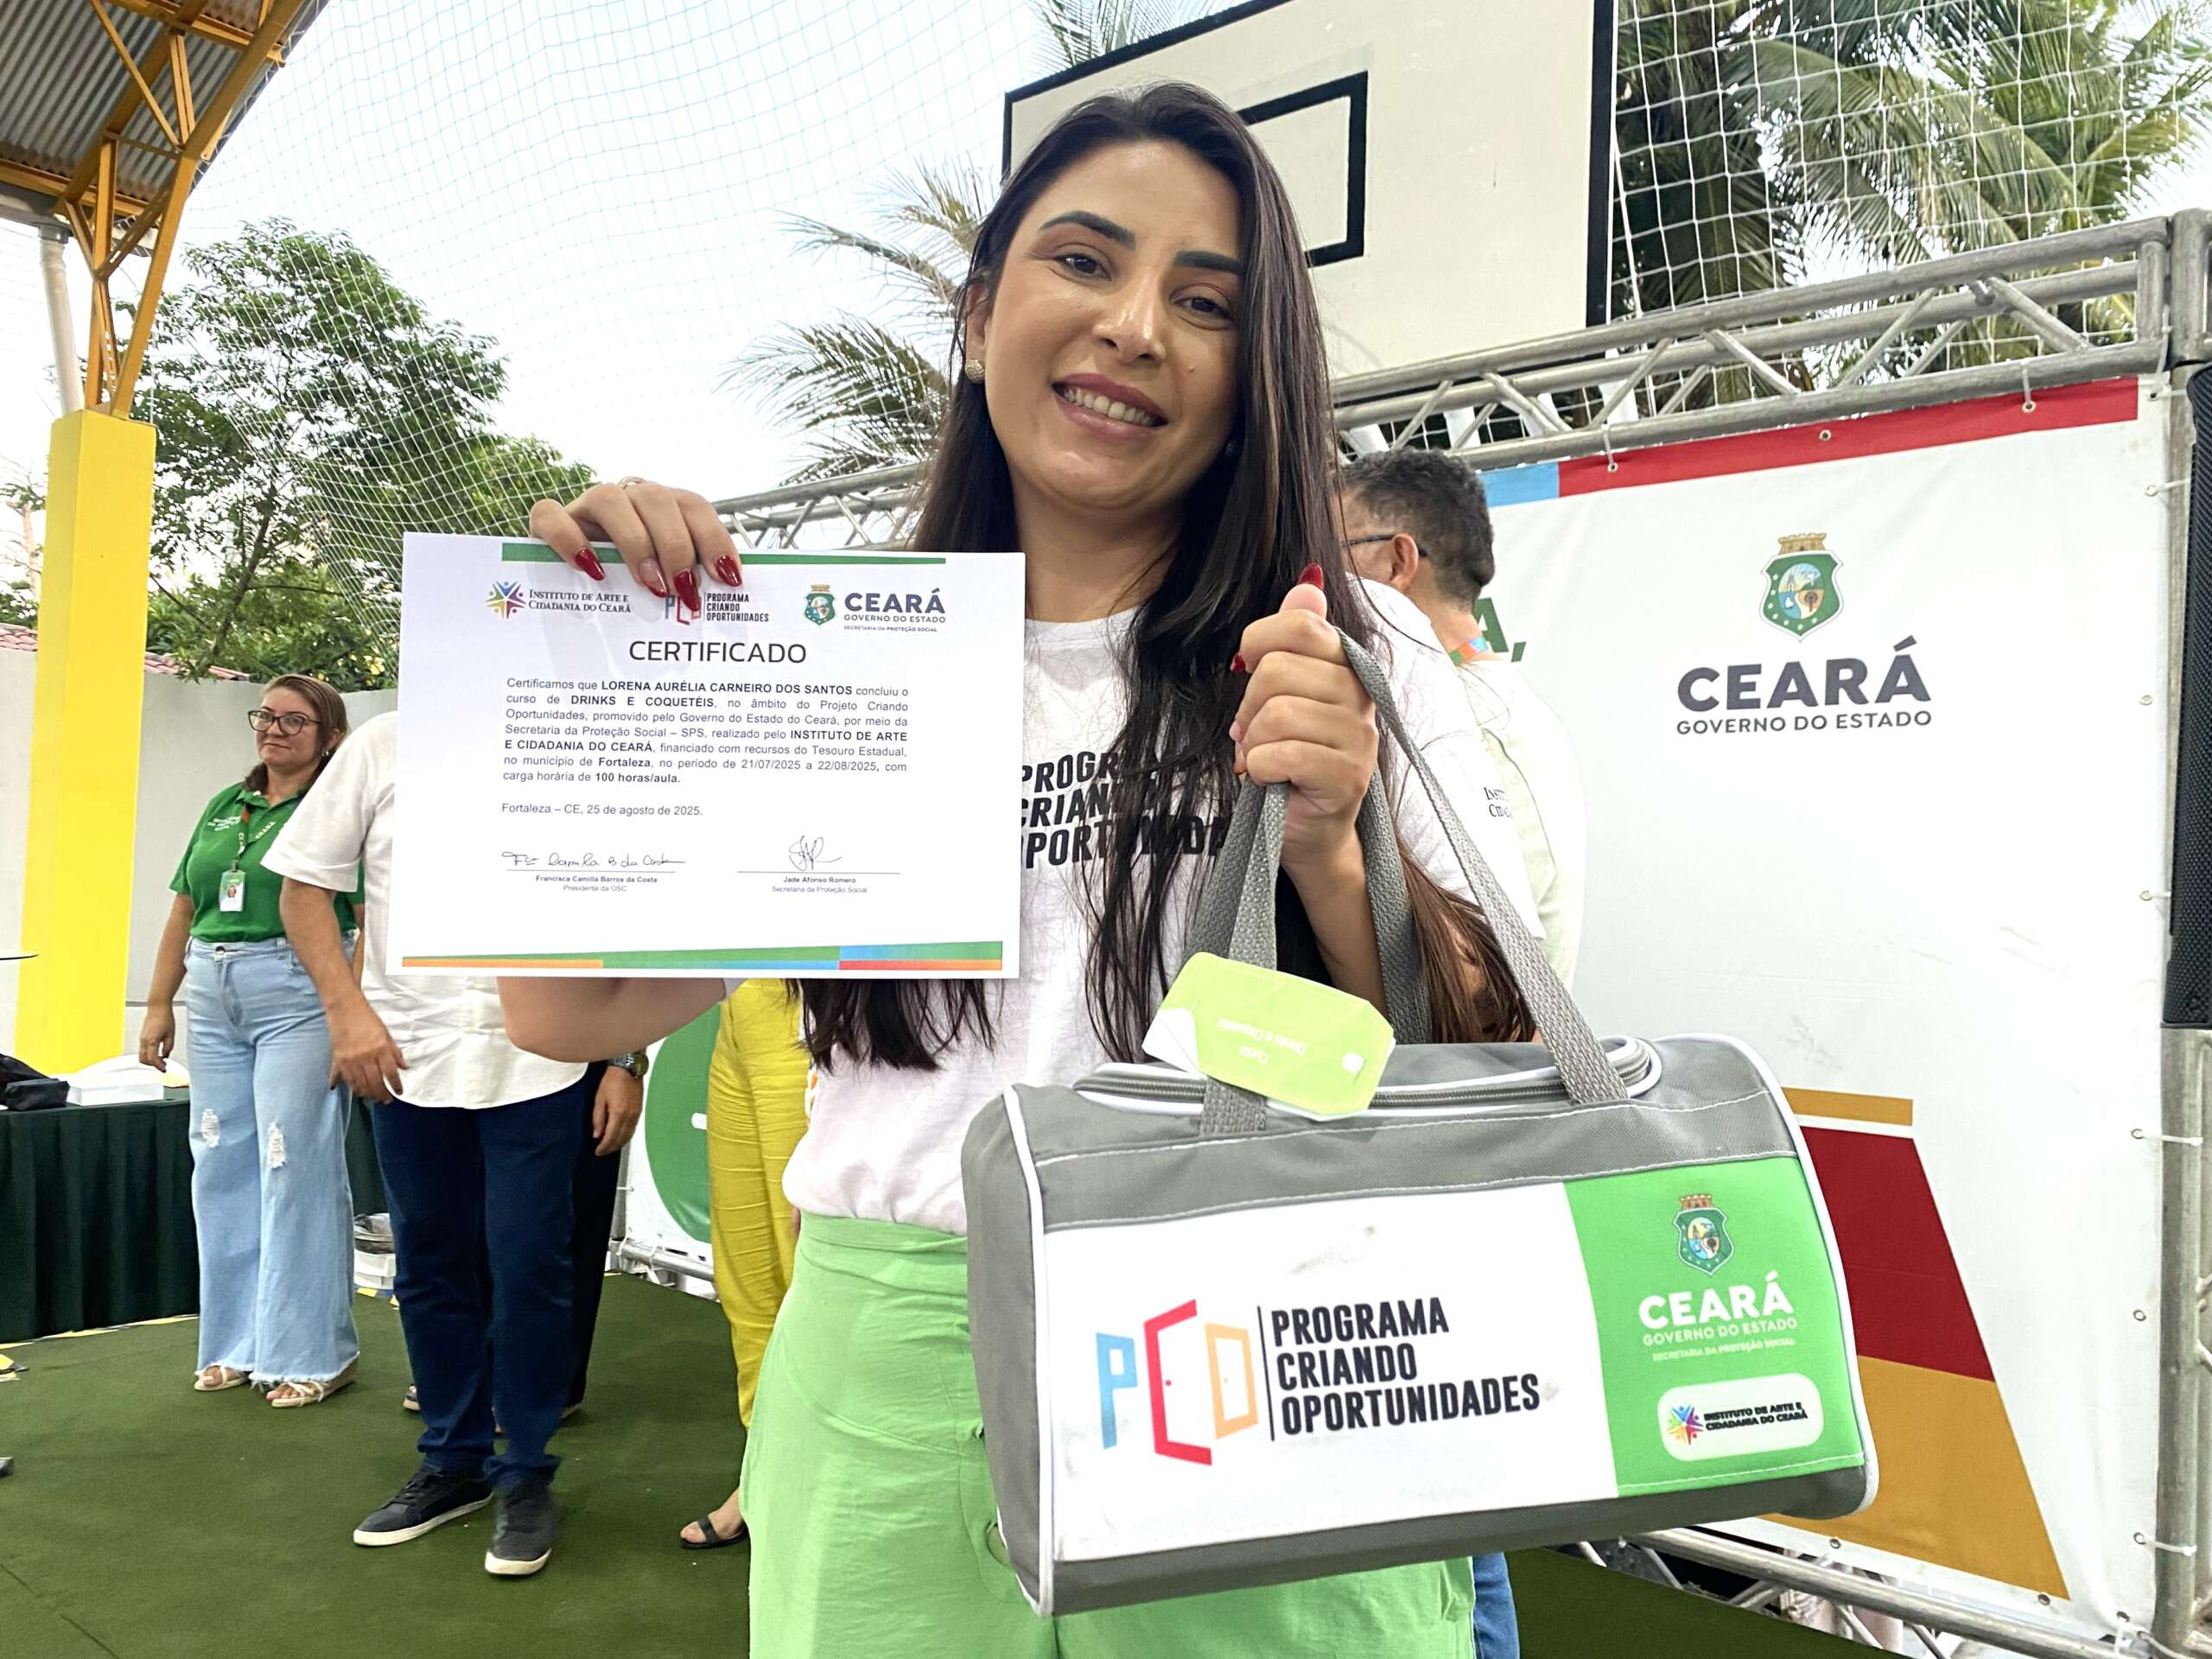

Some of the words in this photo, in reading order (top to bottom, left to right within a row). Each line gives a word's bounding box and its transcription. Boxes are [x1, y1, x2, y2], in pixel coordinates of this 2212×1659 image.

[530, 589, 579, 601] INSTITUTO
[595, 593, 620, 602] ARTE
[707, 593, 749, 602] PROGRAMA
[844, 588, 945, 613] CEARÁ
[529, 601, 580, 611] CIDADANIA
[599, 603, 631, 613] CEARÁ
[707, 603, 740, 612] CRIANDO
[707, 612, 769, 622] OPORTUNIDADES
[629, 640, 807, 664] CERTIFICADO
[1678, 635, 1931, 712] CEARÁ
[507, 677, 574, 690] Certificamos
[578, 682, 597, 691] que
[601, 681, 651, 690] LORENA
[655, 680, 706, 691] AURÉLIA
[710, 683, 772, 693] CARNEIRO
[776, 684, 800, 693] DOS
[804, 685, 852, 695] SANTOS
[856, 687, 898, 696] concluiu
[547, 695, 560, 703] de
[571, 696, 616, 705] DRINKS
[645, 696, 717, 708] COQUETÉIS,
[751, 698, 786, 709] âmbito
[797, 700, 810, 709] do
[820, 700, 857, 711] Projeto
[868, 701, 908, 711] Criando
[506, 709, 588, 721] Oportunidades,
[593, 711, 648, 722] promovido
[653, 712, 675, 723] pelo
[680, 713, 724, 722] Governo
[729, 714, 741, 722] do
[747, 714, 783, 724] Estado
[788, 715, 800, 724] do
[804, 715, 840, 726] Ceará,
[844, 717, 861, 727] por
[866, 716, 890, 726] meio
[895, 717, 907, 727] da
[1677, 716, 1786, 734] GOVERNO
[1795, 715, 1827, 730] DO
[1837, 711, 1931, 729] ESTADO
[505, 724, 560, 734] Secretaria
[565, 726, 577, 735] da
[582, 726, 630, 738] Proteção
[634, 727, 666, 736] Social
[681, 728, 707, 739] SPS,
[712, 729, 760, 739] realizado
[765, 730, 786, 741] pelo
[791, 730, 852, 740] INSTITUTO
[856, 732, 872, 741] DE
[876, 732, 907, 741] ARTE
[518, 741, 584, 750] CIDADANIA
[588, 741, 606, 751] DO
[611, 741, 656, 753] CEARÁ,
[660, 742, 715, 754] financiado
[794, 746, 807, 754] do
[812, 746, 855, 755] Tesouro
[859, 747, 906, 757] Estadual,
[523, 755, 574, 766] município
[580, 757, 593, 766] de
[599, 757, 653, 768] Fortaleza,
[723, 760, 735, 768] de
[741, 760, 800, 770] 21/07/2025
[818, 760, 879, 772] 22/08/2025,
[503, 772, 533, 782] carga
[537, 771, 574, 781] horária
[578, 772, 591, 781] de
[596, 772, 614, 782] 100
[618, 772, 681, 783] horas/aula.
[502, 803, 551, 813] Fortaleza
[564, 804, 583, 815] CE,
[587, 804, 600, 814] 25
[603, 805, 616, 815] de
[620, 806, 655, 817] agosto
[658, 805, 671, 815] de
[674, 805, 702, 816] 2025.
[1639, 1270, 1795, 1330] CEARÁ
[1272, 1296, 1450, 1347] PROGRAMA
[1643, 1327, 1714, 1346] GOVERNO
[1718, 1324, 1739, 1338] DO
[1743, 1318, 1797, 1335] ESTADO
[1276, 1343, 1418, 1391] CRIANDO
[1281, 1373, 1541, 1435] OPORTUNIDADES
[1704, 1408, 1752, 1421] INSTITUTO
[1755, 1406, 1768, 1414] DE
[1770, 1403, 1794, 1414] ARTE
[1706, 1416, 1758, 1431] CIDADANIA
[1760, 1414, 1774, 1424] DO
[1777, 1409, 1808, 1422] CEARÁ
